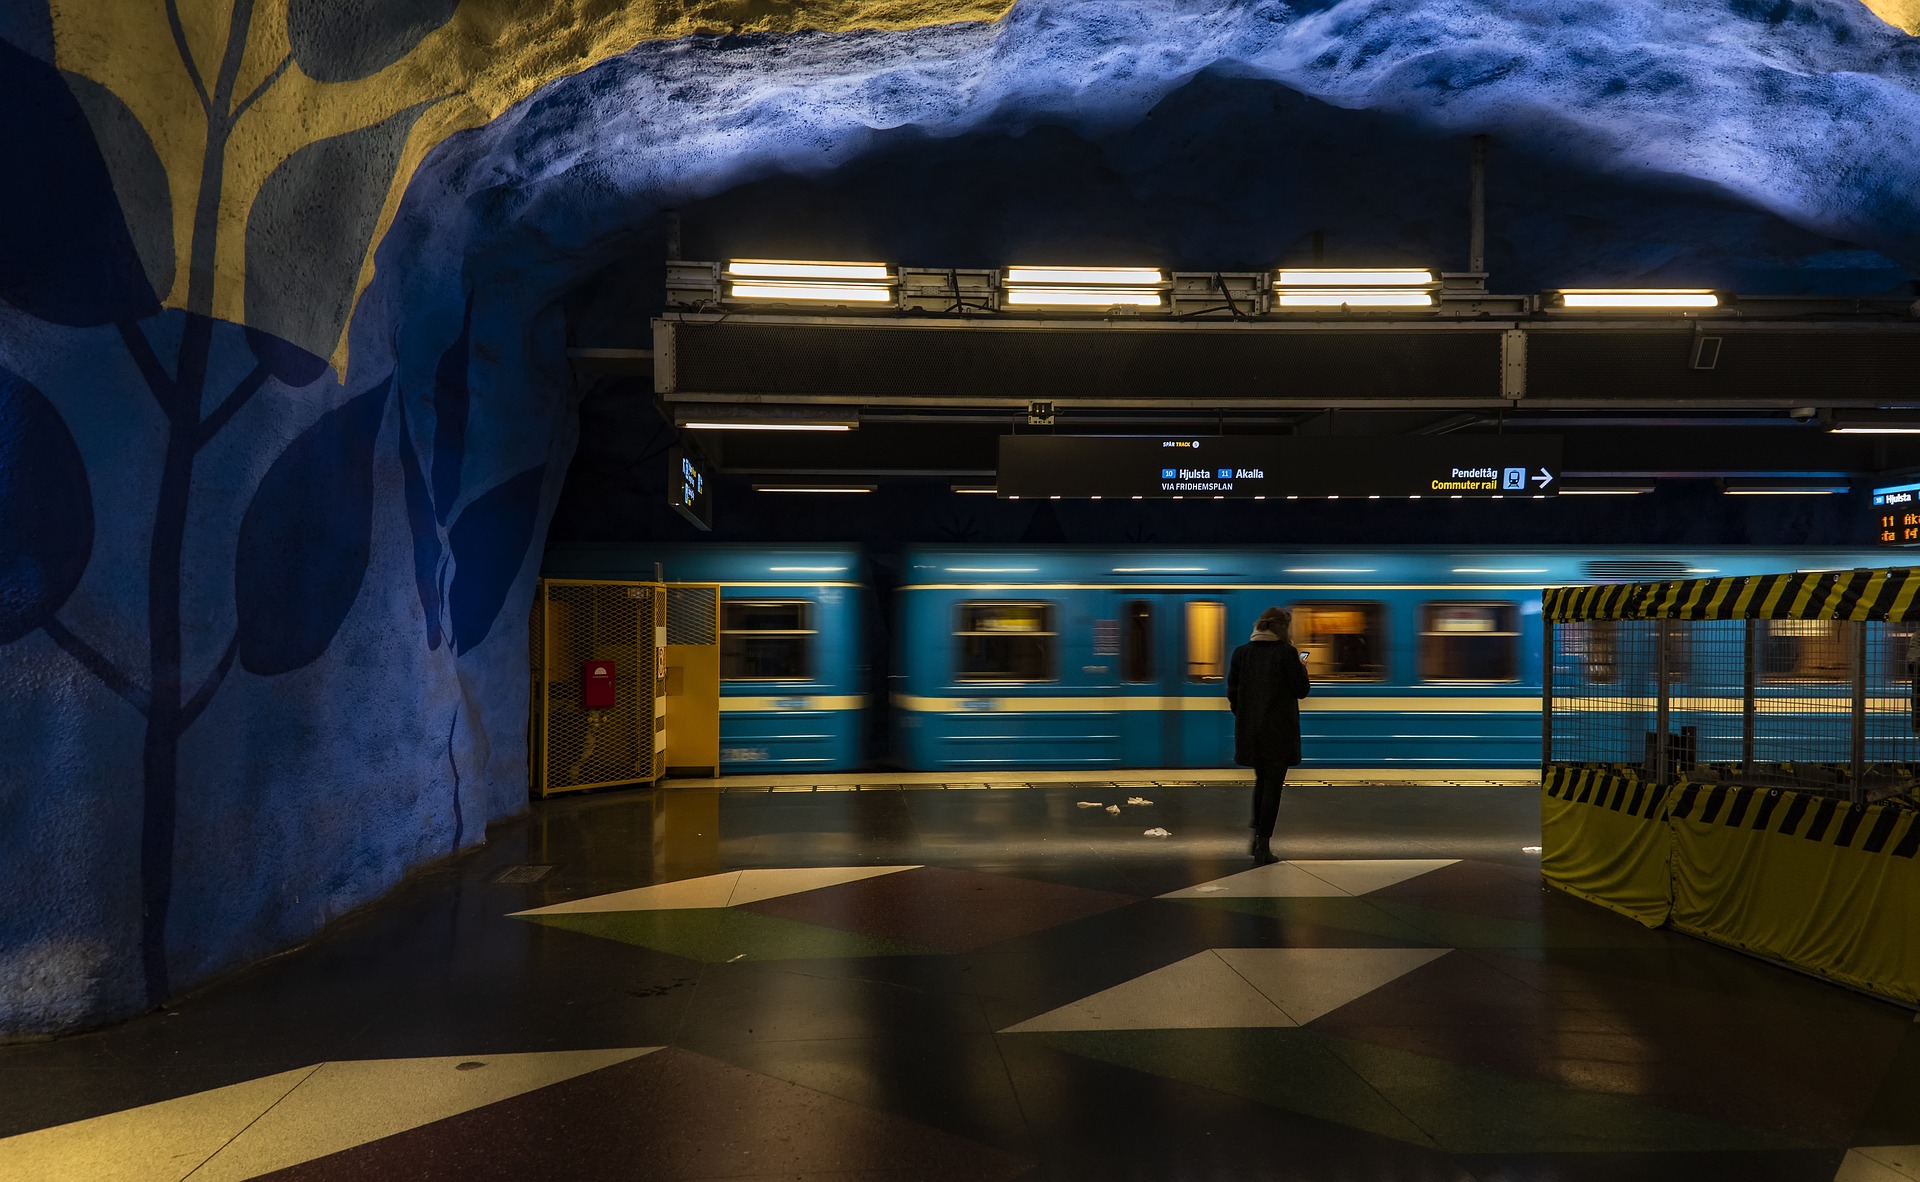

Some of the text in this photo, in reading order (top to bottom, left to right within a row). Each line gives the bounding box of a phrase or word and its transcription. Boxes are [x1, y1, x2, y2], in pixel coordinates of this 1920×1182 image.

[1179, 469, 1211, 480] Hjulsta
[1236, 469, 1264, 478] Akalla
[1452, 468, 1498, 479] Pendeltåg
[1162, 483, 1233, 491] VIA FRIDHEMSPLAN
[1431, 479, 1497, 490] Commuter rail
[1885, 493, 1912, 504] Hjulsta
[1881, 515, 1894, 527] 11
